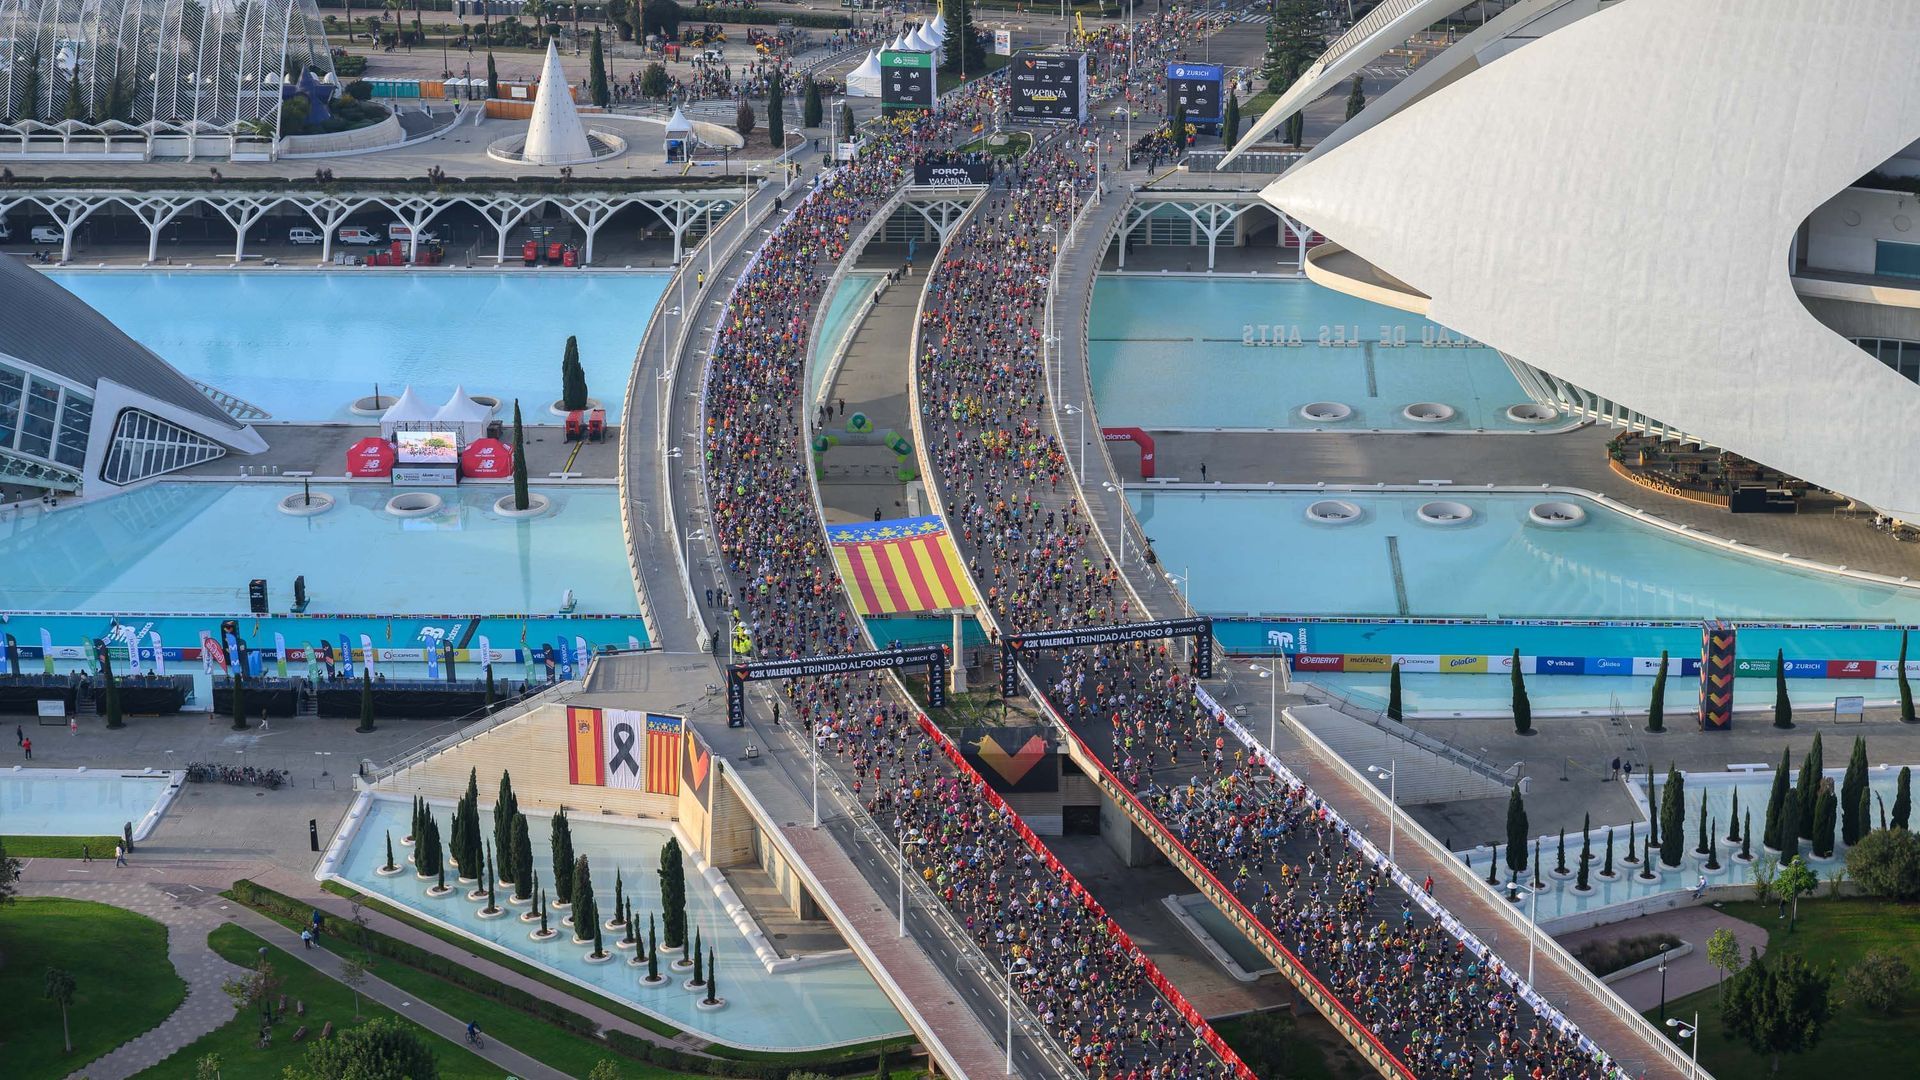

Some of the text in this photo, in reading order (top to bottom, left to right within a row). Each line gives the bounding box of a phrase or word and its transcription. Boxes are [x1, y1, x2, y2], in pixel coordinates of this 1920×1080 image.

[932, 168, 968, 177] FORÇA,
[1631, 473, 1682, 497] CONTRAPUNTO
[1073, 626, 1118, 634] TRINIDAD
[1117, 620, 1162, 630] ALFONSO
[1023, 639, 1039, 649] 42K
[1039, 636, 1075, 648] VALENCIA
[1076, 632, 1119, 644] TRINIDAD
[1119, 628, 1163, 640] ALFONSO
[749, 655, 928, 679] 42K VALENCIA TRINIDAD ALFONSO ZURICH
[763, 658, 801, 667] VALENCIA
[801, 654, 846, 663] TRINIDAD
[846, 650, 892, 660] ALFONSO
